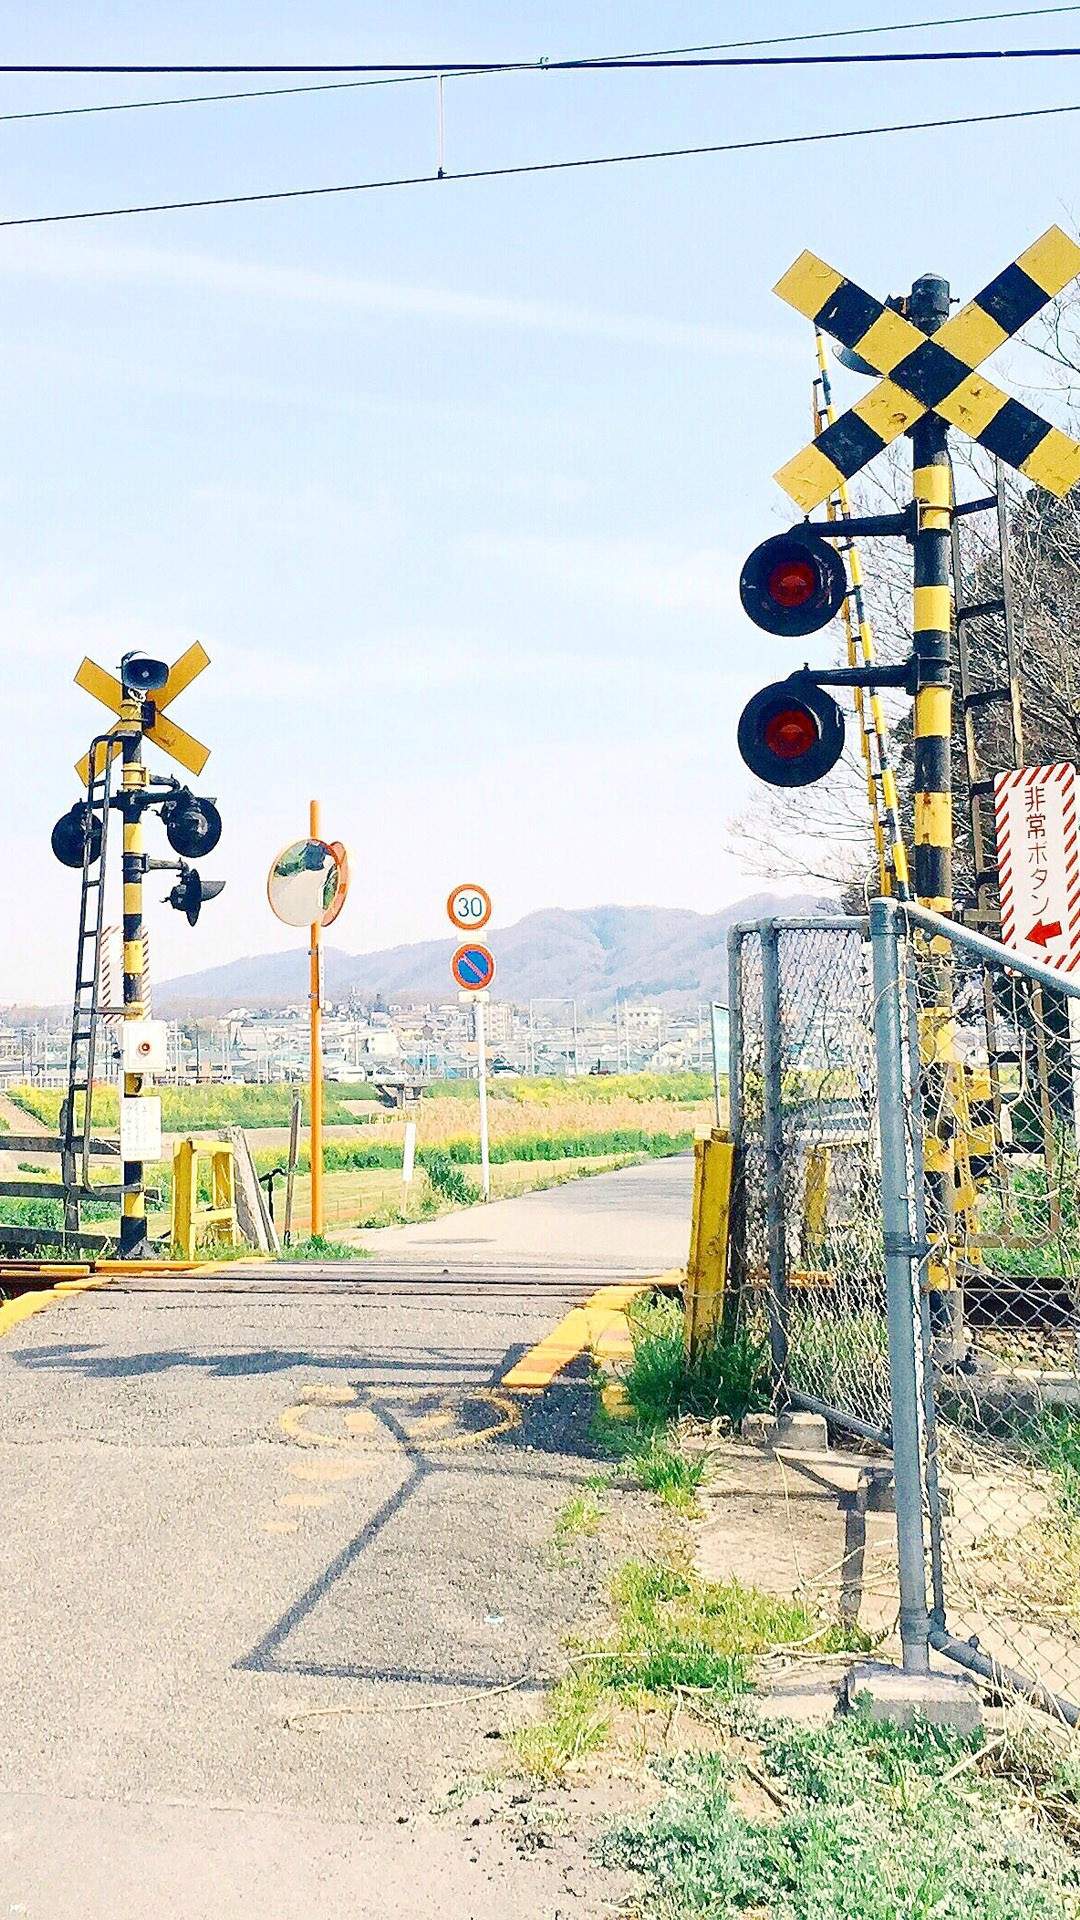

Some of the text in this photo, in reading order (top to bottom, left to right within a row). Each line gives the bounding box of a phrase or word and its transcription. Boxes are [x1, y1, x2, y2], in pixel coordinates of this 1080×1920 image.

[1024, 785, 1050, 916] 非常ボタン
[458, 897, 483, 917] 30
